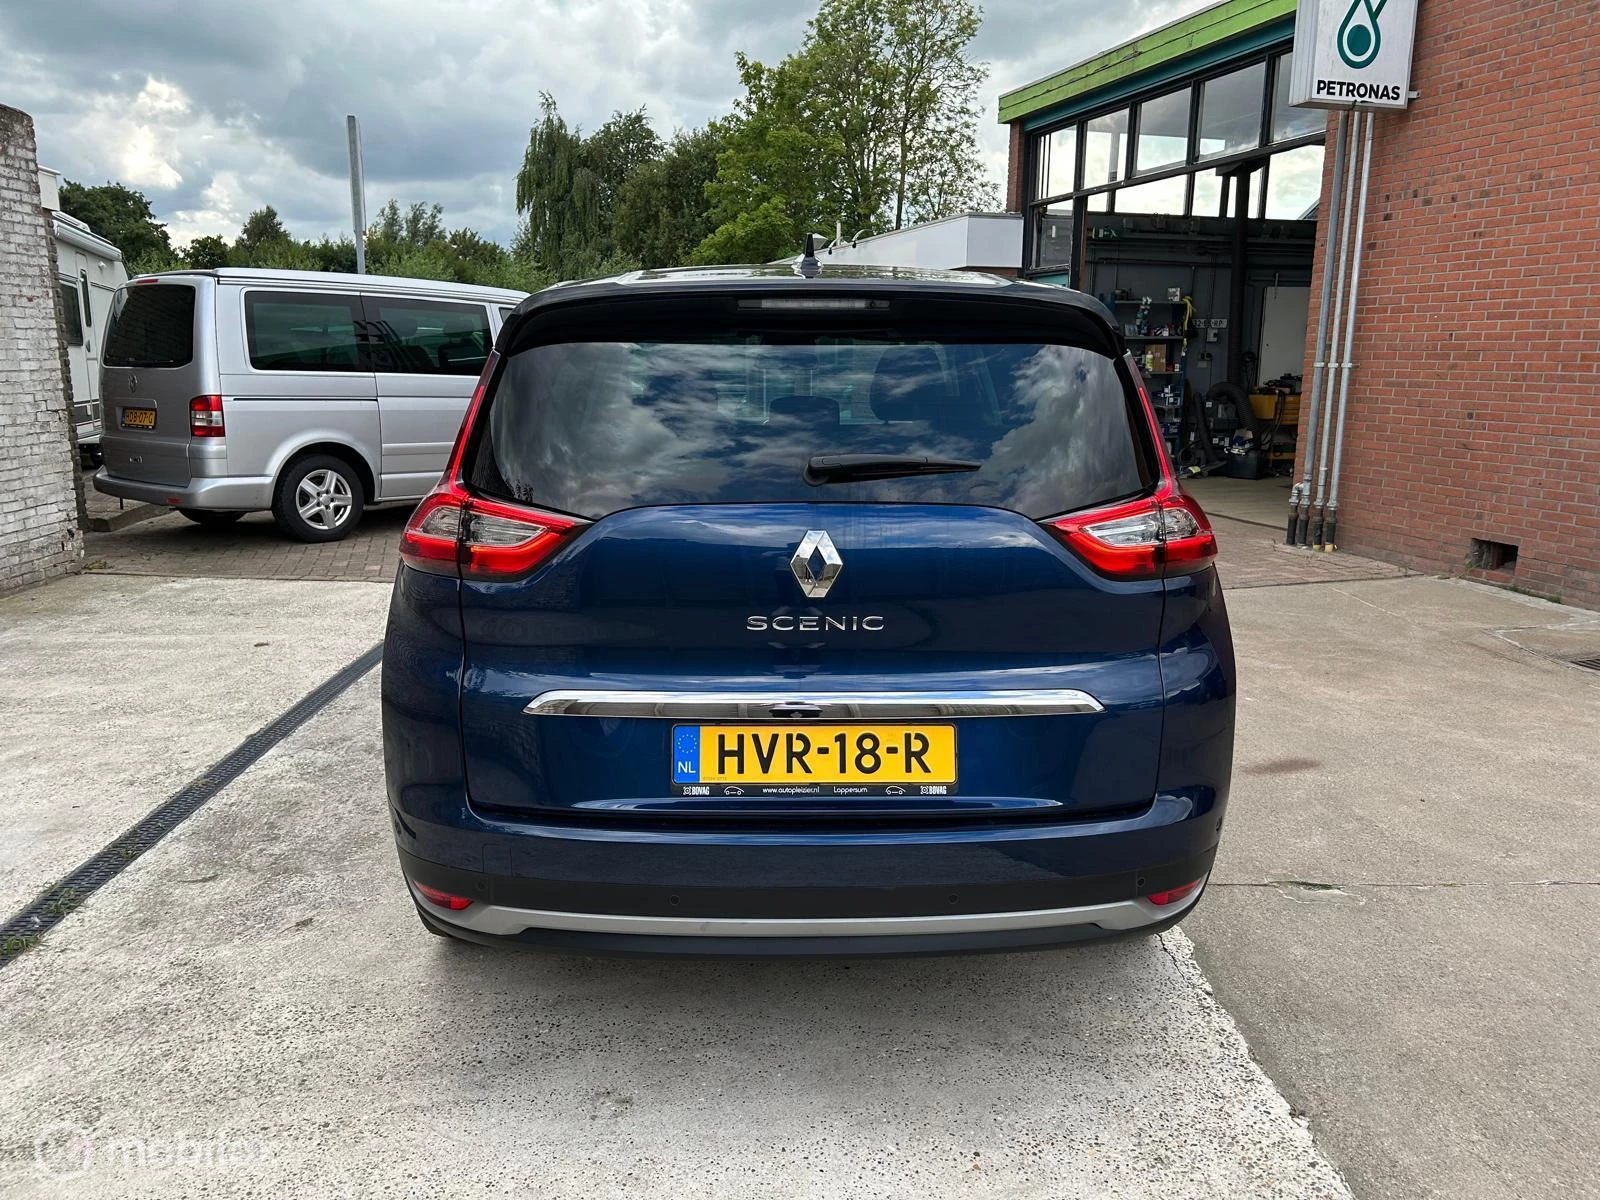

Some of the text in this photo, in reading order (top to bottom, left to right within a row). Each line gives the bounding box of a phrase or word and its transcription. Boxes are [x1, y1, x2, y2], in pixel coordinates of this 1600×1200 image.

[1316, 79, 1401, 101] PETRONAS
[746, 615, 885, 631] SCENIC
[717, 732, 931, 775] HVR-18-R
[677, 760, 697, 774] NL
[691, 786, 710, 796] BOVAG
[833, 786, 868, 796] Loppersum
[928, 785, 947, 795] BOVAG
